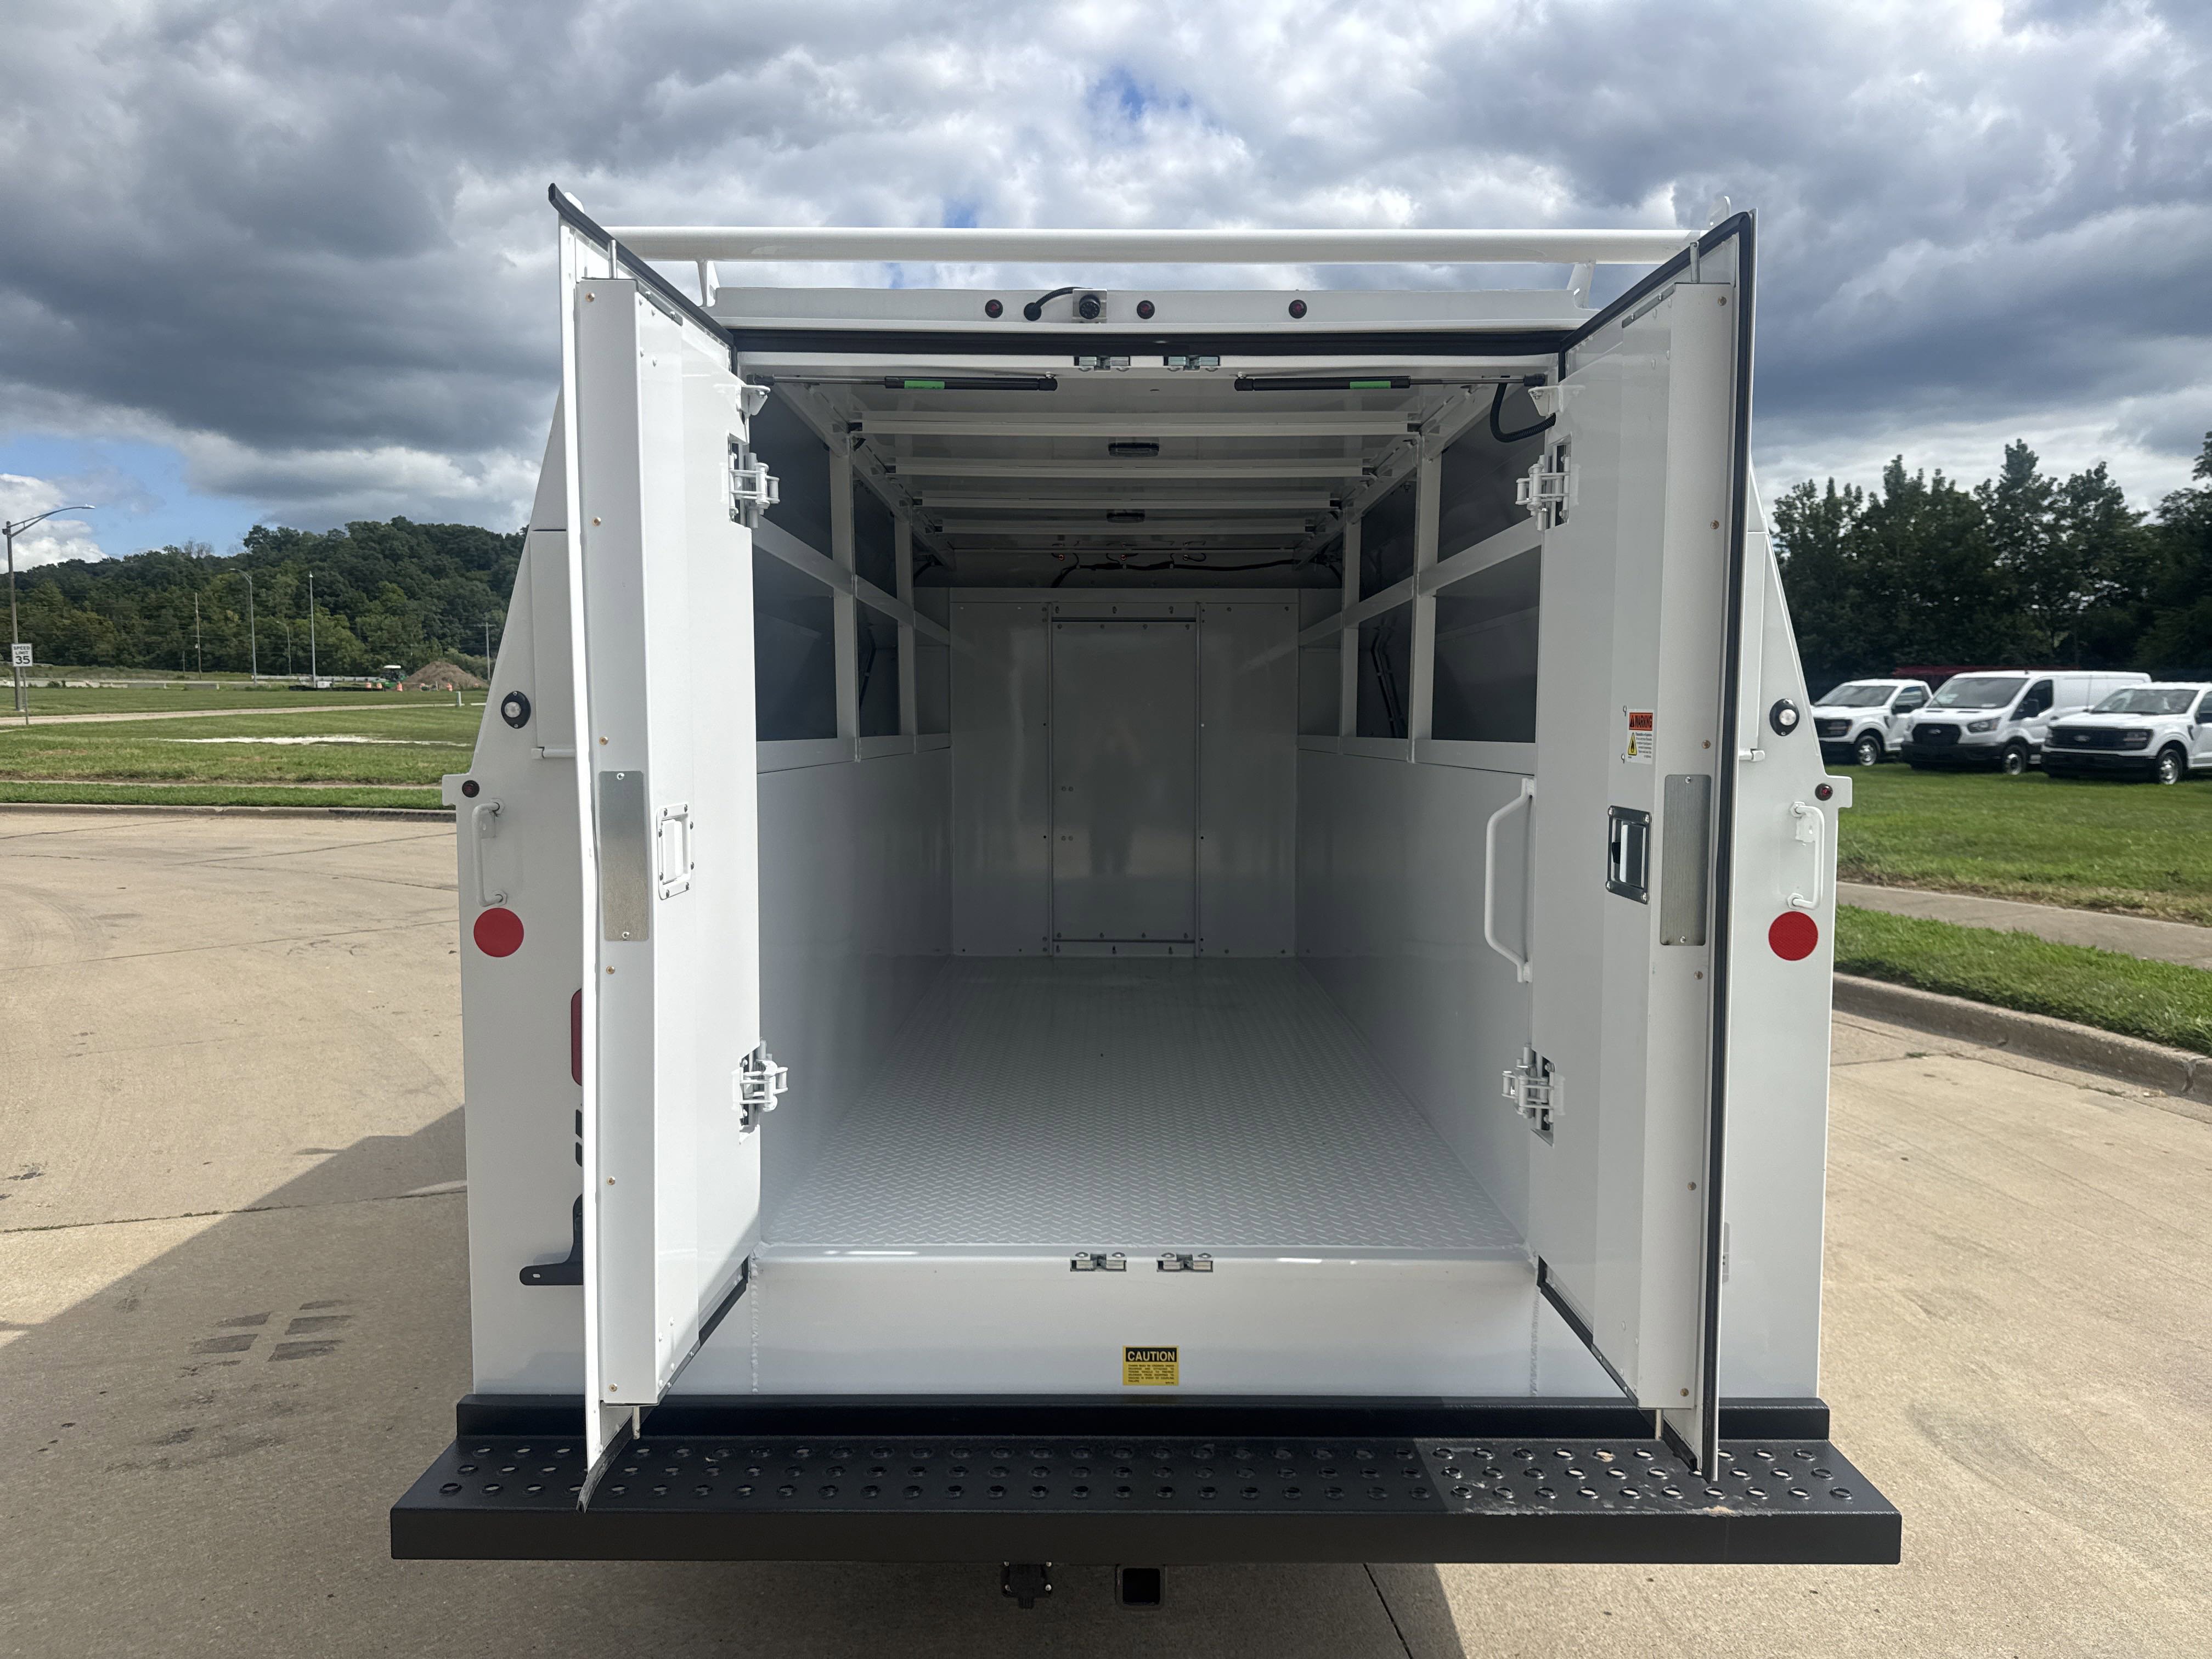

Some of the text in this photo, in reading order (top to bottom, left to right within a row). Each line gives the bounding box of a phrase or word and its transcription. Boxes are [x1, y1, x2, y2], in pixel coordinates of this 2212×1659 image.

[15, 656, 30, 664] 35
[1635, 715, 1652, 729] WARNING
[1127, 1351, 1175, 1362] CAUTION
